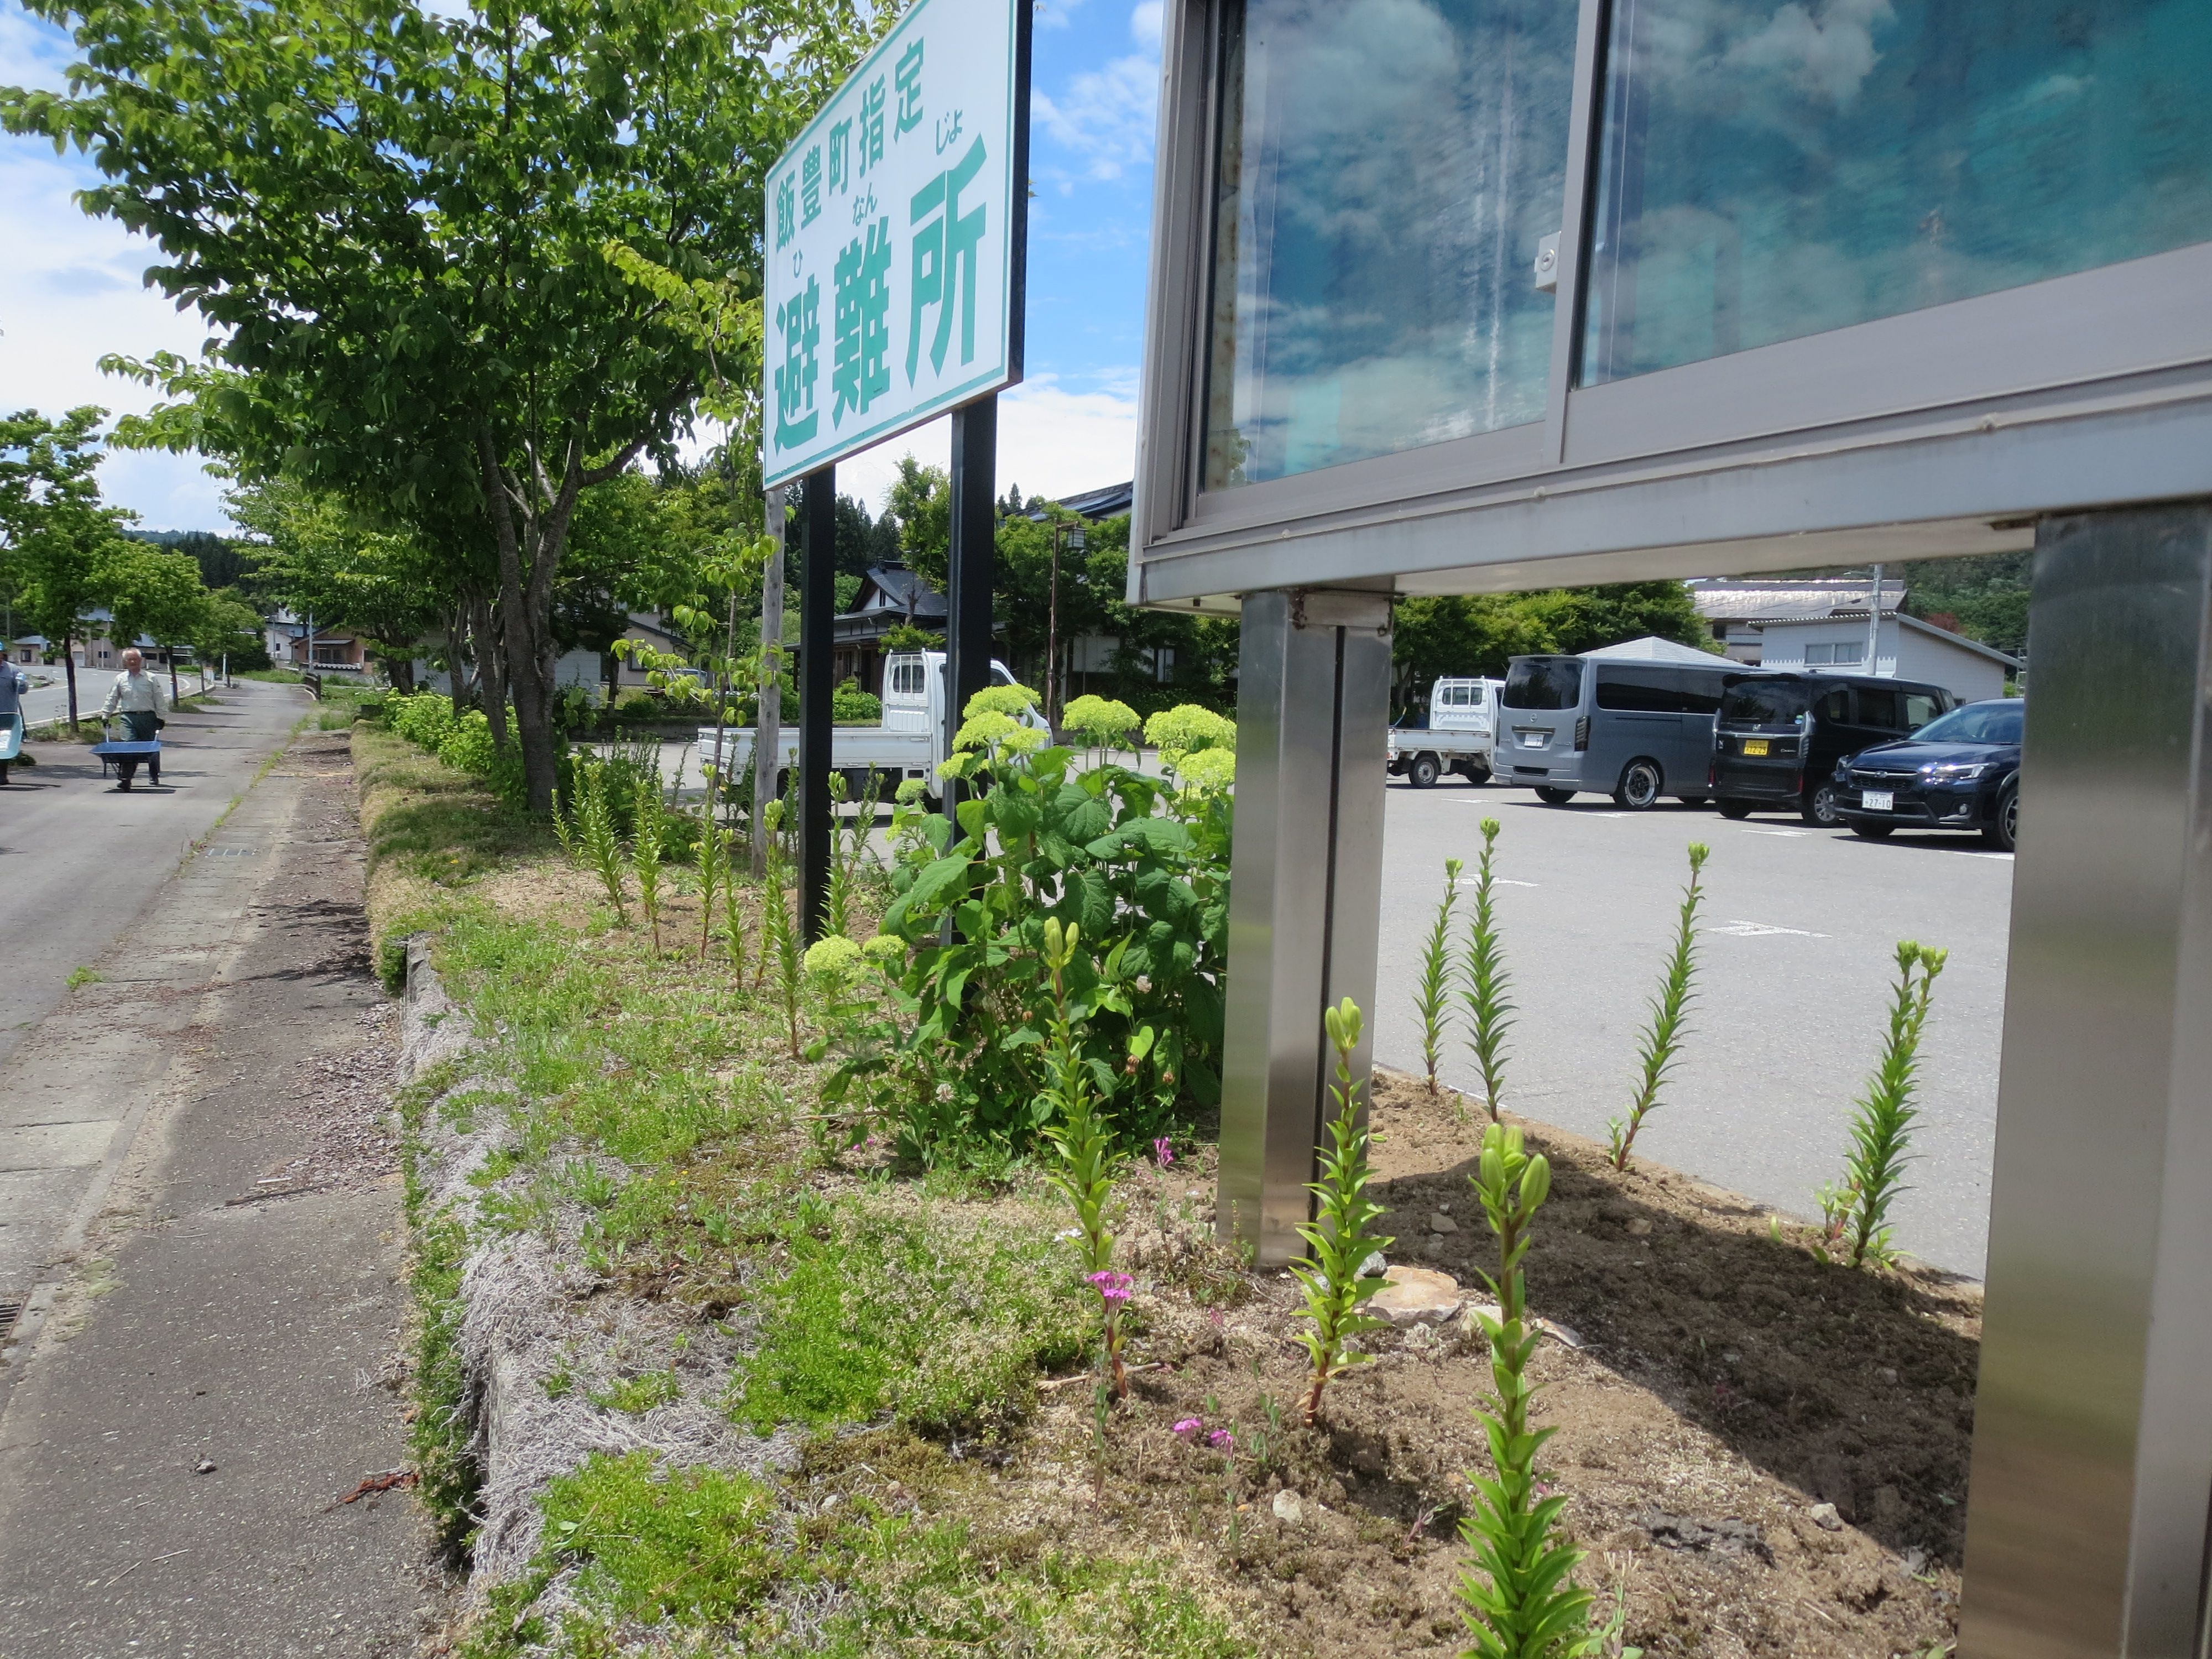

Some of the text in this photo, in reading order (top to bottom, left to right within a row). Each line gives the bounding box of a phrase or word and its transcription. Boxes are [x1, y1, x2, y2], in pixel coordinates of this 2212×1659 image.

[776, 35, 924, 254] 飯豊町指定
[792, 109, 963, 279] ひ なん じょ
[774, 132, 987, 456] 避難所
[1869, 799, 1891, 808] 27-10
